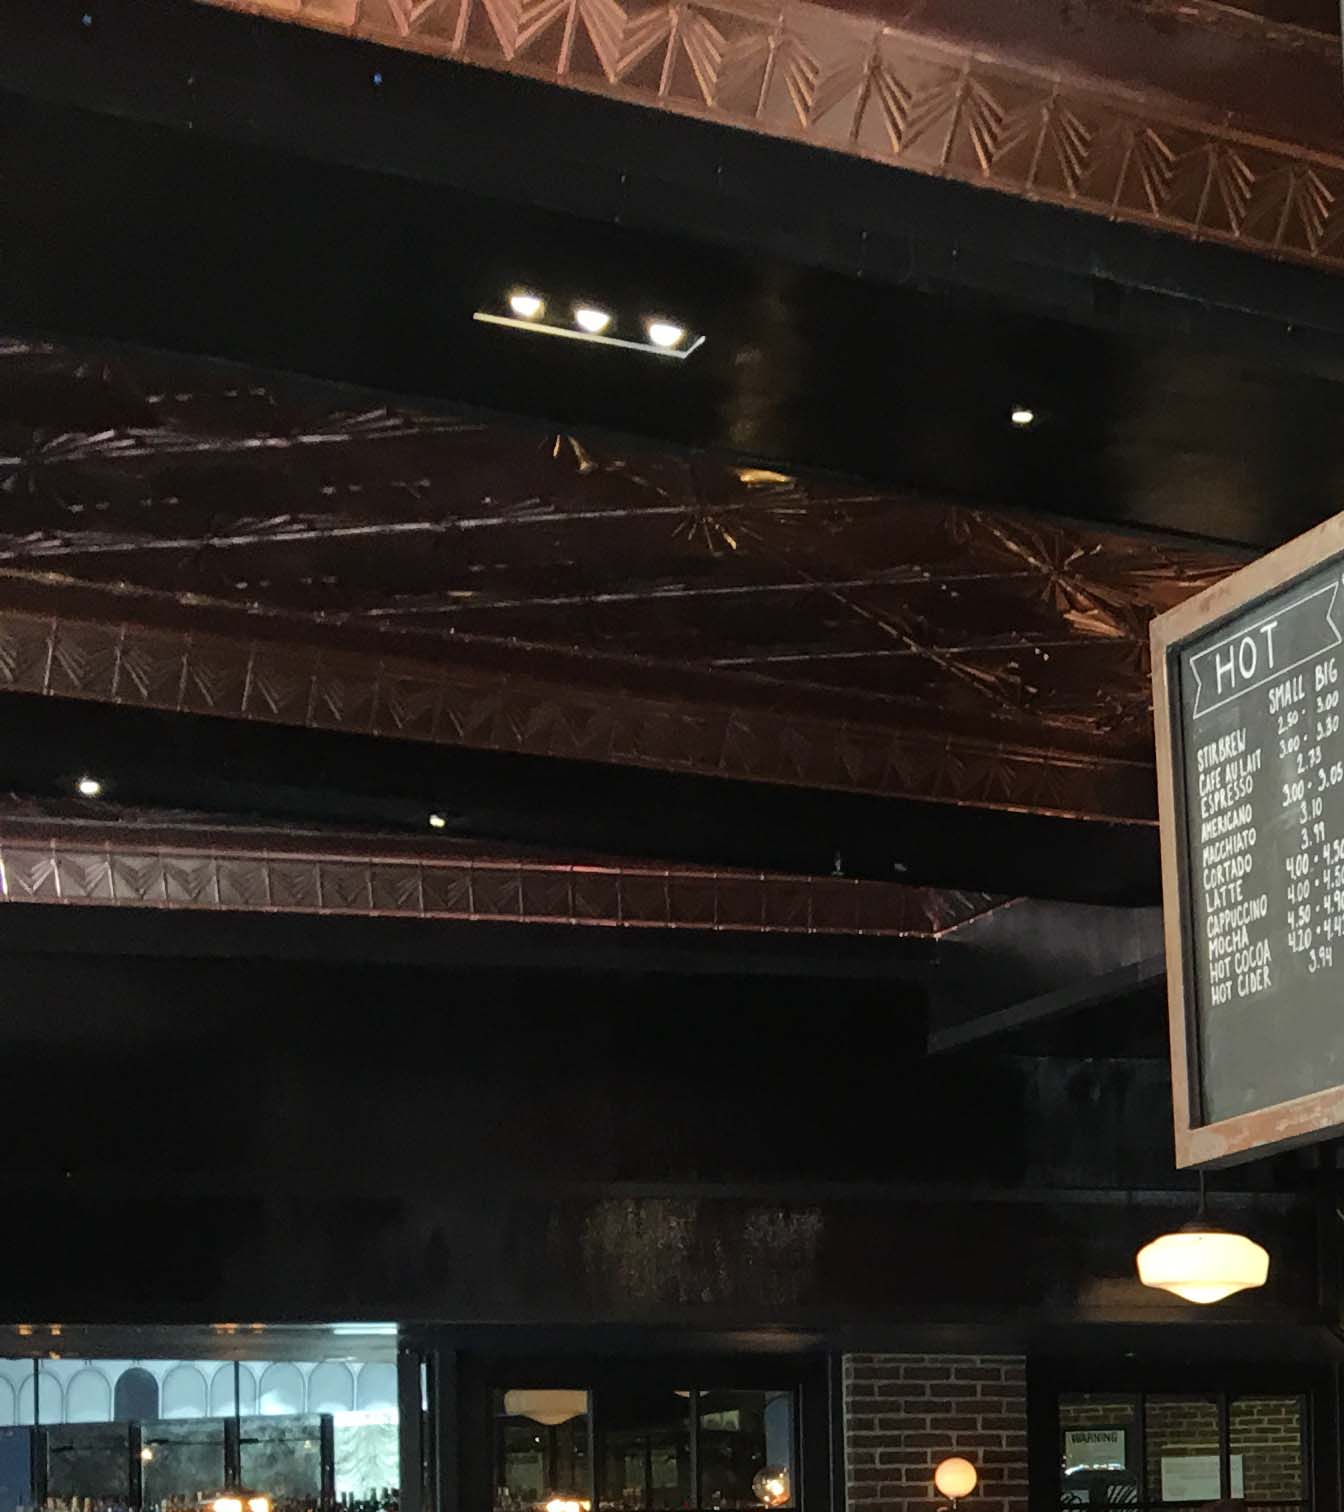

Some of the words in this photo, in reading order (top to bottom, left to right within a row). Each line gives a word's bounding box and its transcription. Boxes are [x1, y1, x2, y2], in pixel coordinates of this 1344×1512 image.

[1216, 621, 1278, 694] HOT
[1268, 674, 1305, 714] SMALL
[1315, 658, 1338, 692] BIG
[1200, 767, 1221, 797] CAFE
[1200, 775, 1253, 819] ESPRESSO
[1201, 803, 1253, 844] AMERICANO
[1202, 827, 1257, 868] MACCHIATO
[1203, 854, 1253, 890] CORTADO
[1205, 879, 1244, 912] LATTE
[1206, 894, 1268, 938] CAPPUCCINO
[1288, 879, 1310, 905] 4.00
[1208, 925, 1249, 960] MOCHA
[1288, 904, 1311, 930] 4.50
[1209, 957, 1232, 984] HOT
[1234, 938, 1272, 974] COCOA
[1211, 981, 1232, 1006] HOT
[1237, 966, 1272, 997] CIDER
[1309, 946, 1333, 974] 3.94
[1071, 1432, 1118, 1443] WARNING
